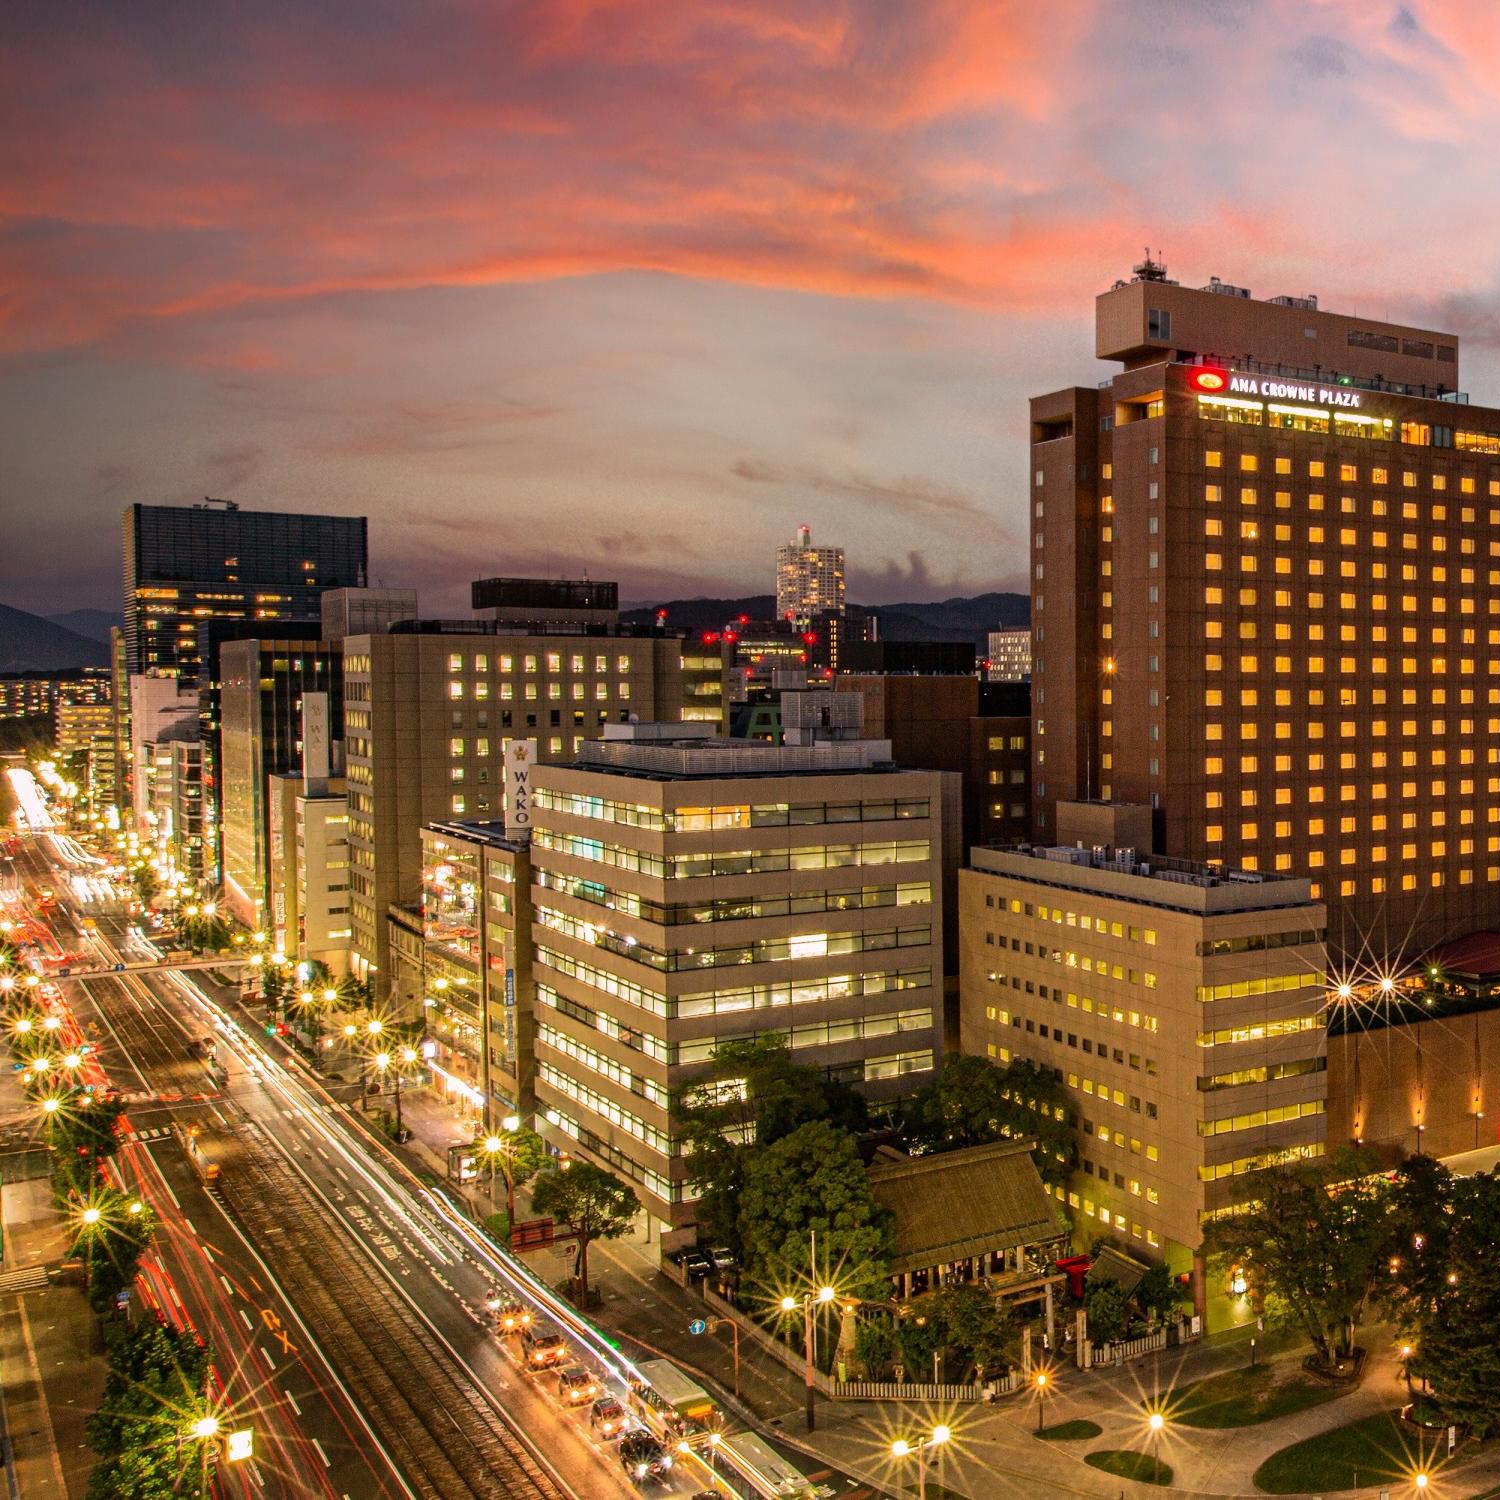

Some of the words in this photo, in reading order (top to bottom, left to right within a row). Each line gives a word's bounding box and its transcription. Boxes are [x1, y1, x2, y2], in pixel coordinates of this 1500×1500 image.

[1230, 377, 1258, 394] ANA
[1261, 381, 1315, 402] CROWNE
[1319, 390, 1360, 407] PLAZA
[515, 771, 529, 824] WAKO
